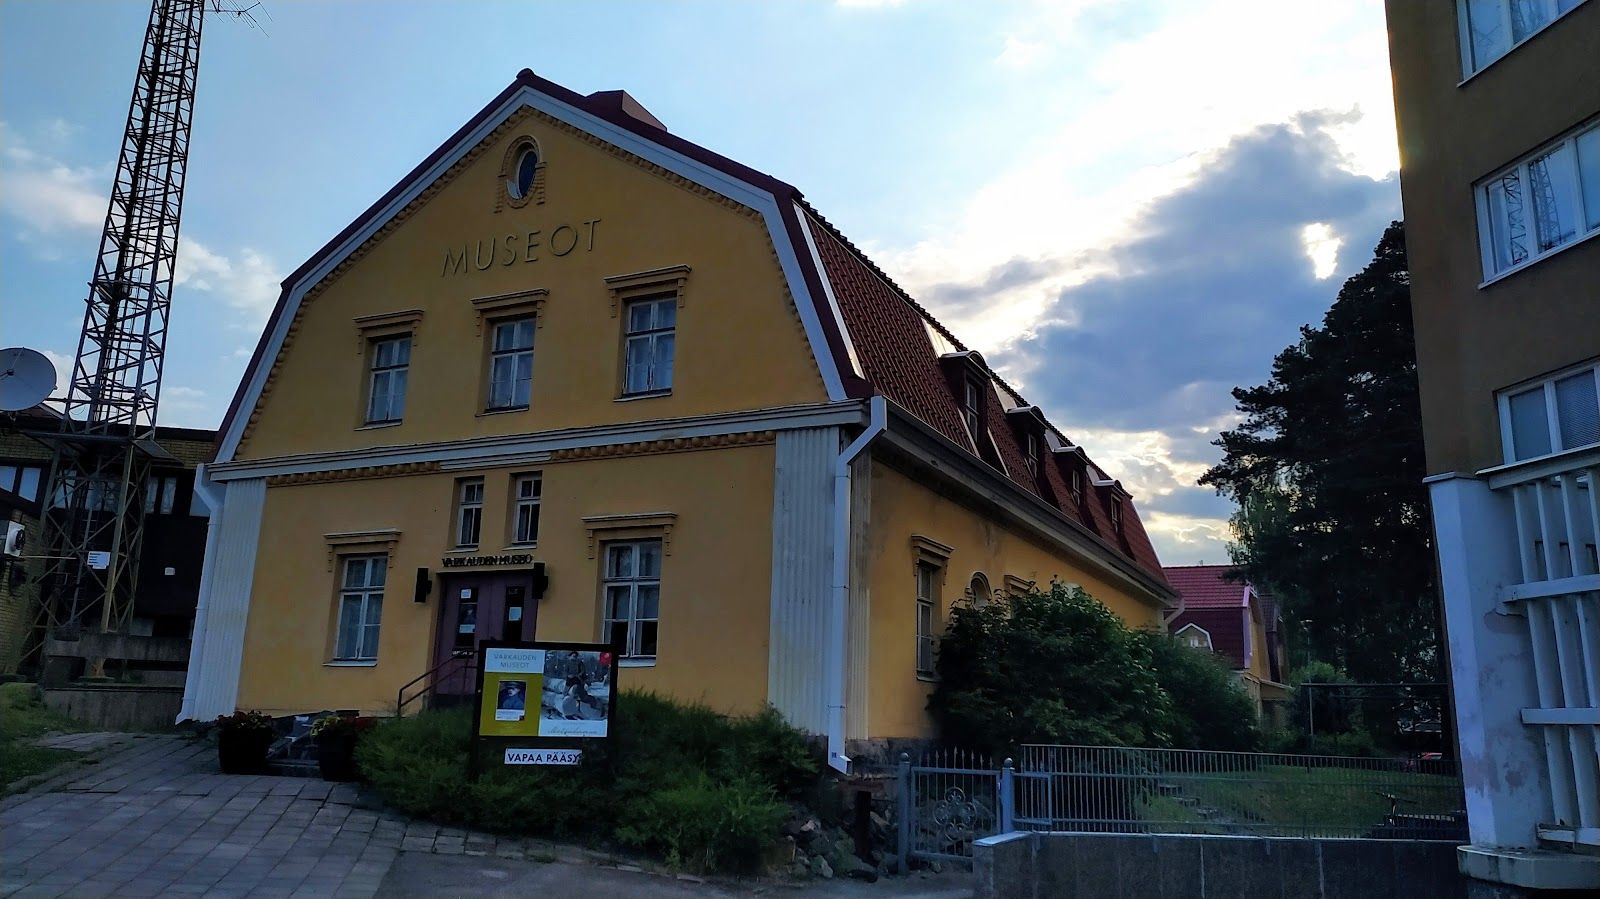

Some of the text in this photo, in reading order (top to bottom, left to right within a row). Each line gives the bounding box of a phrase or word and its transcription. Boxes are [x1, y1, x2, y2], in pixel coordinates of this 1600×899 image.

[441, 218, 602, 278] MUSEOT
[442, 554, 533, 568] VARKAUDEN MUSEO
[494, 652, 537, 661] VARKAUDEN
[500, 661, 530, 669] MUSEOT
[507, 751, 580, 763] VAPAA PÄÄSY
